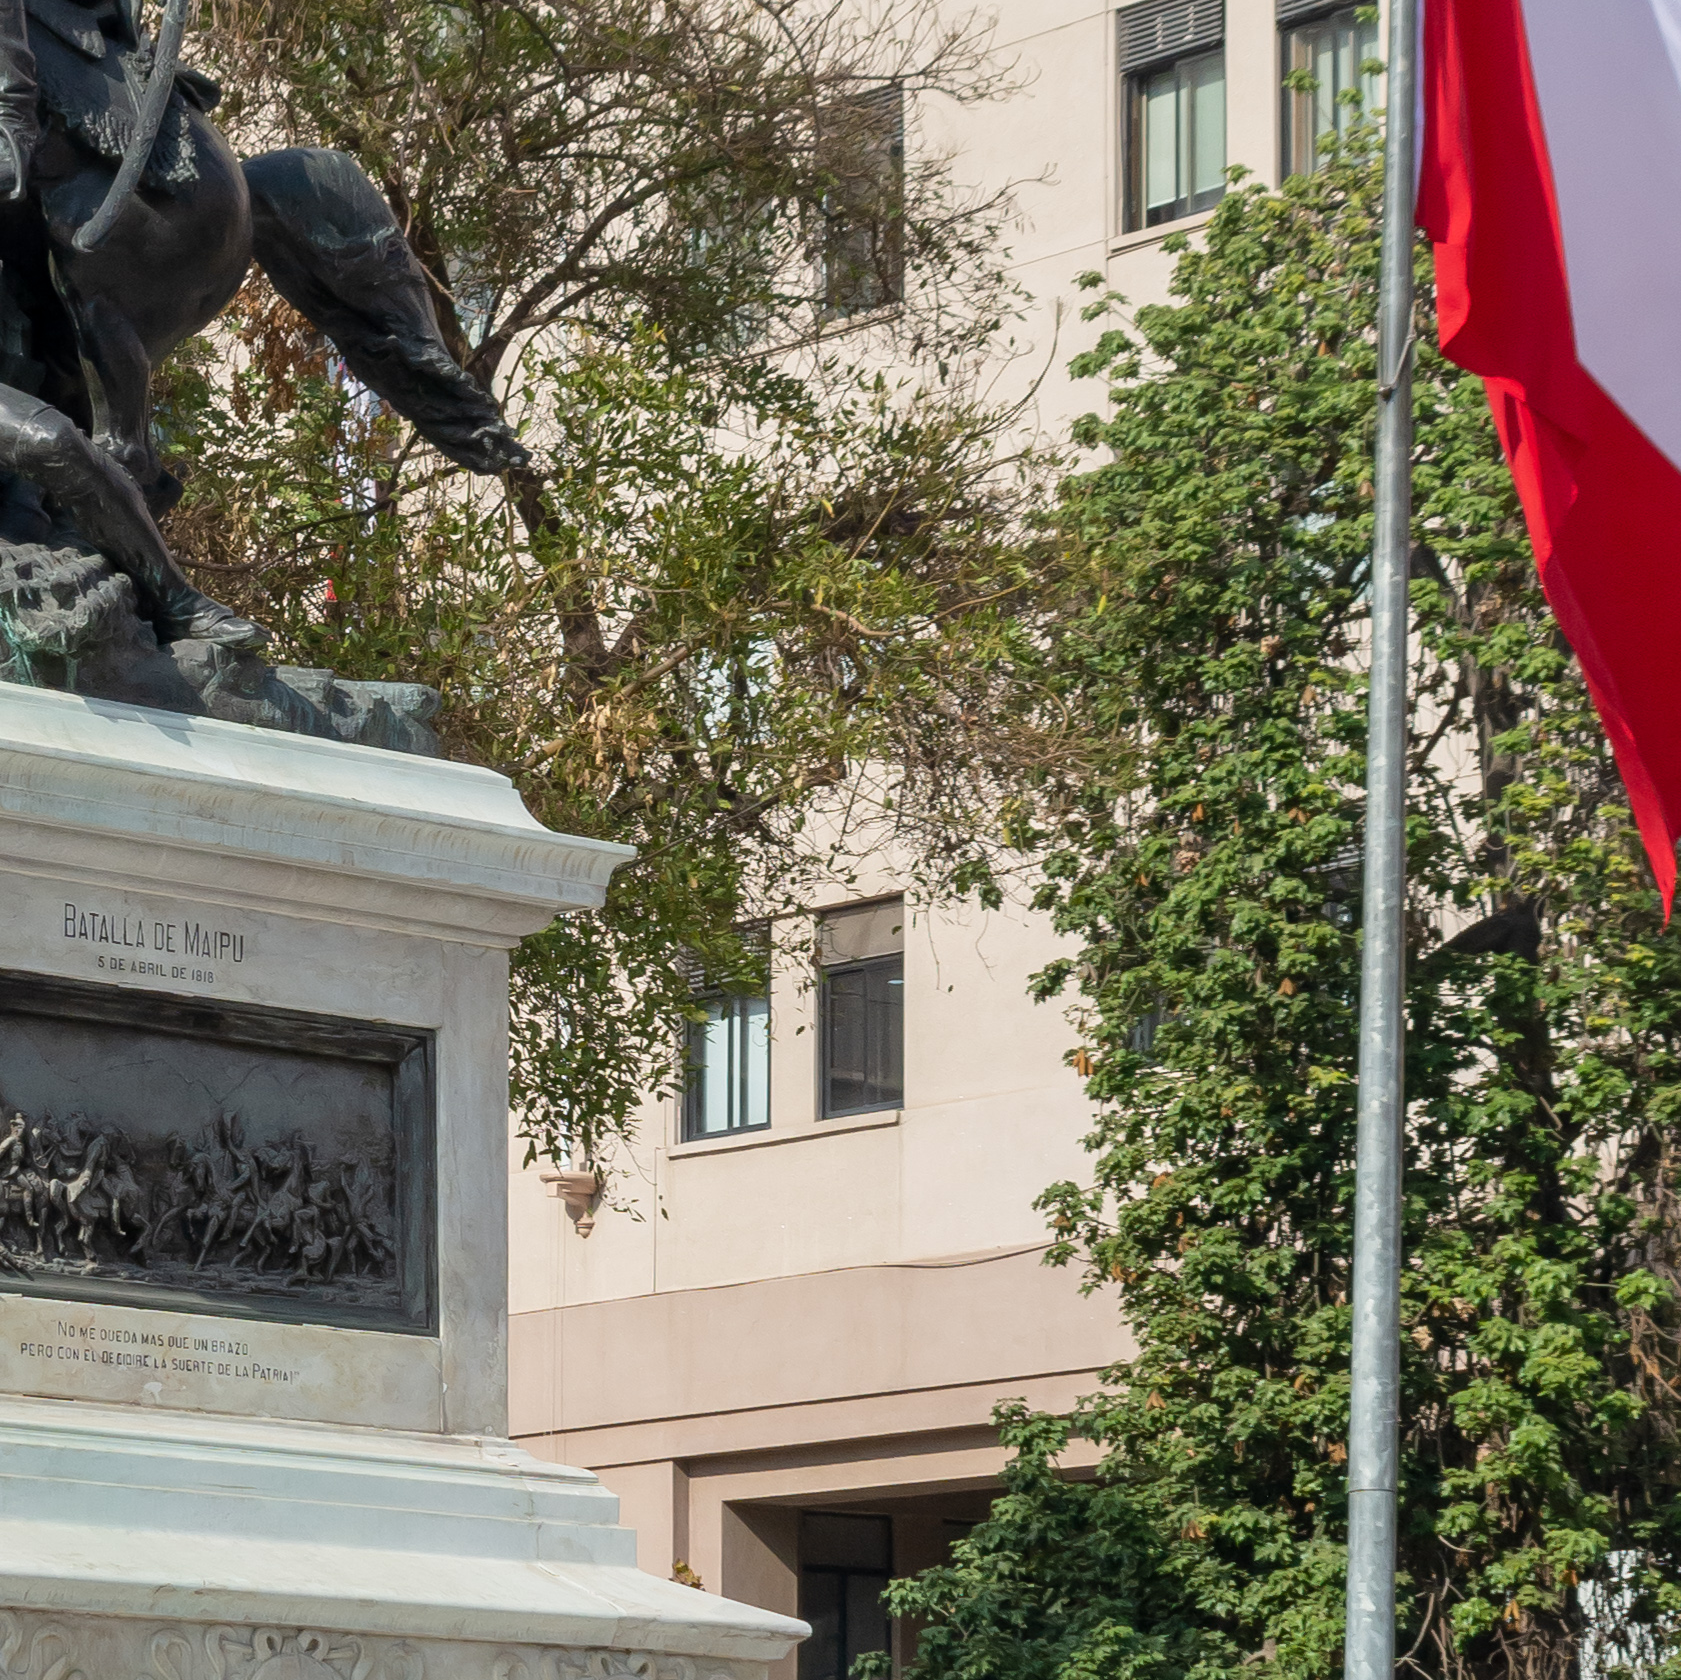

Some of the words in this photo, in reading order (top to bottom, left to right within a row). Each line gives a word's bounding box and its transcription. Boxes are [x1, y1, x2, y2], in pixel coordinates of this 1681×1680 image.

[64, 902, 145, 948] BATALLA
[154, 922, 176, 953] DE
[184, 920, 244, 963] MAIPU
[97, 955, 105, 968] 5
[109, 957, 125, 971] DE
[130, 960, 167, 977] ABRIL
[171, 966, 187, 980] DE
[191, 969, 214, 984] 1818
[79, 1327, 96, 1340] ME
[141, 1333, 164, 1347] MAS
[194, 1338, 208, 1351] UN
[20, 1342, 53, 1358] PERO
[57, 1346, 80, 1360] CON
[84, 1348, 96, 1362] EL
[154, 1357, 167, 1369] LA
[172, 1358, 214, 1374] SUERTE
[217, 1362, 231, 1376] DE
[235, 1365, 249, 1377] LA
